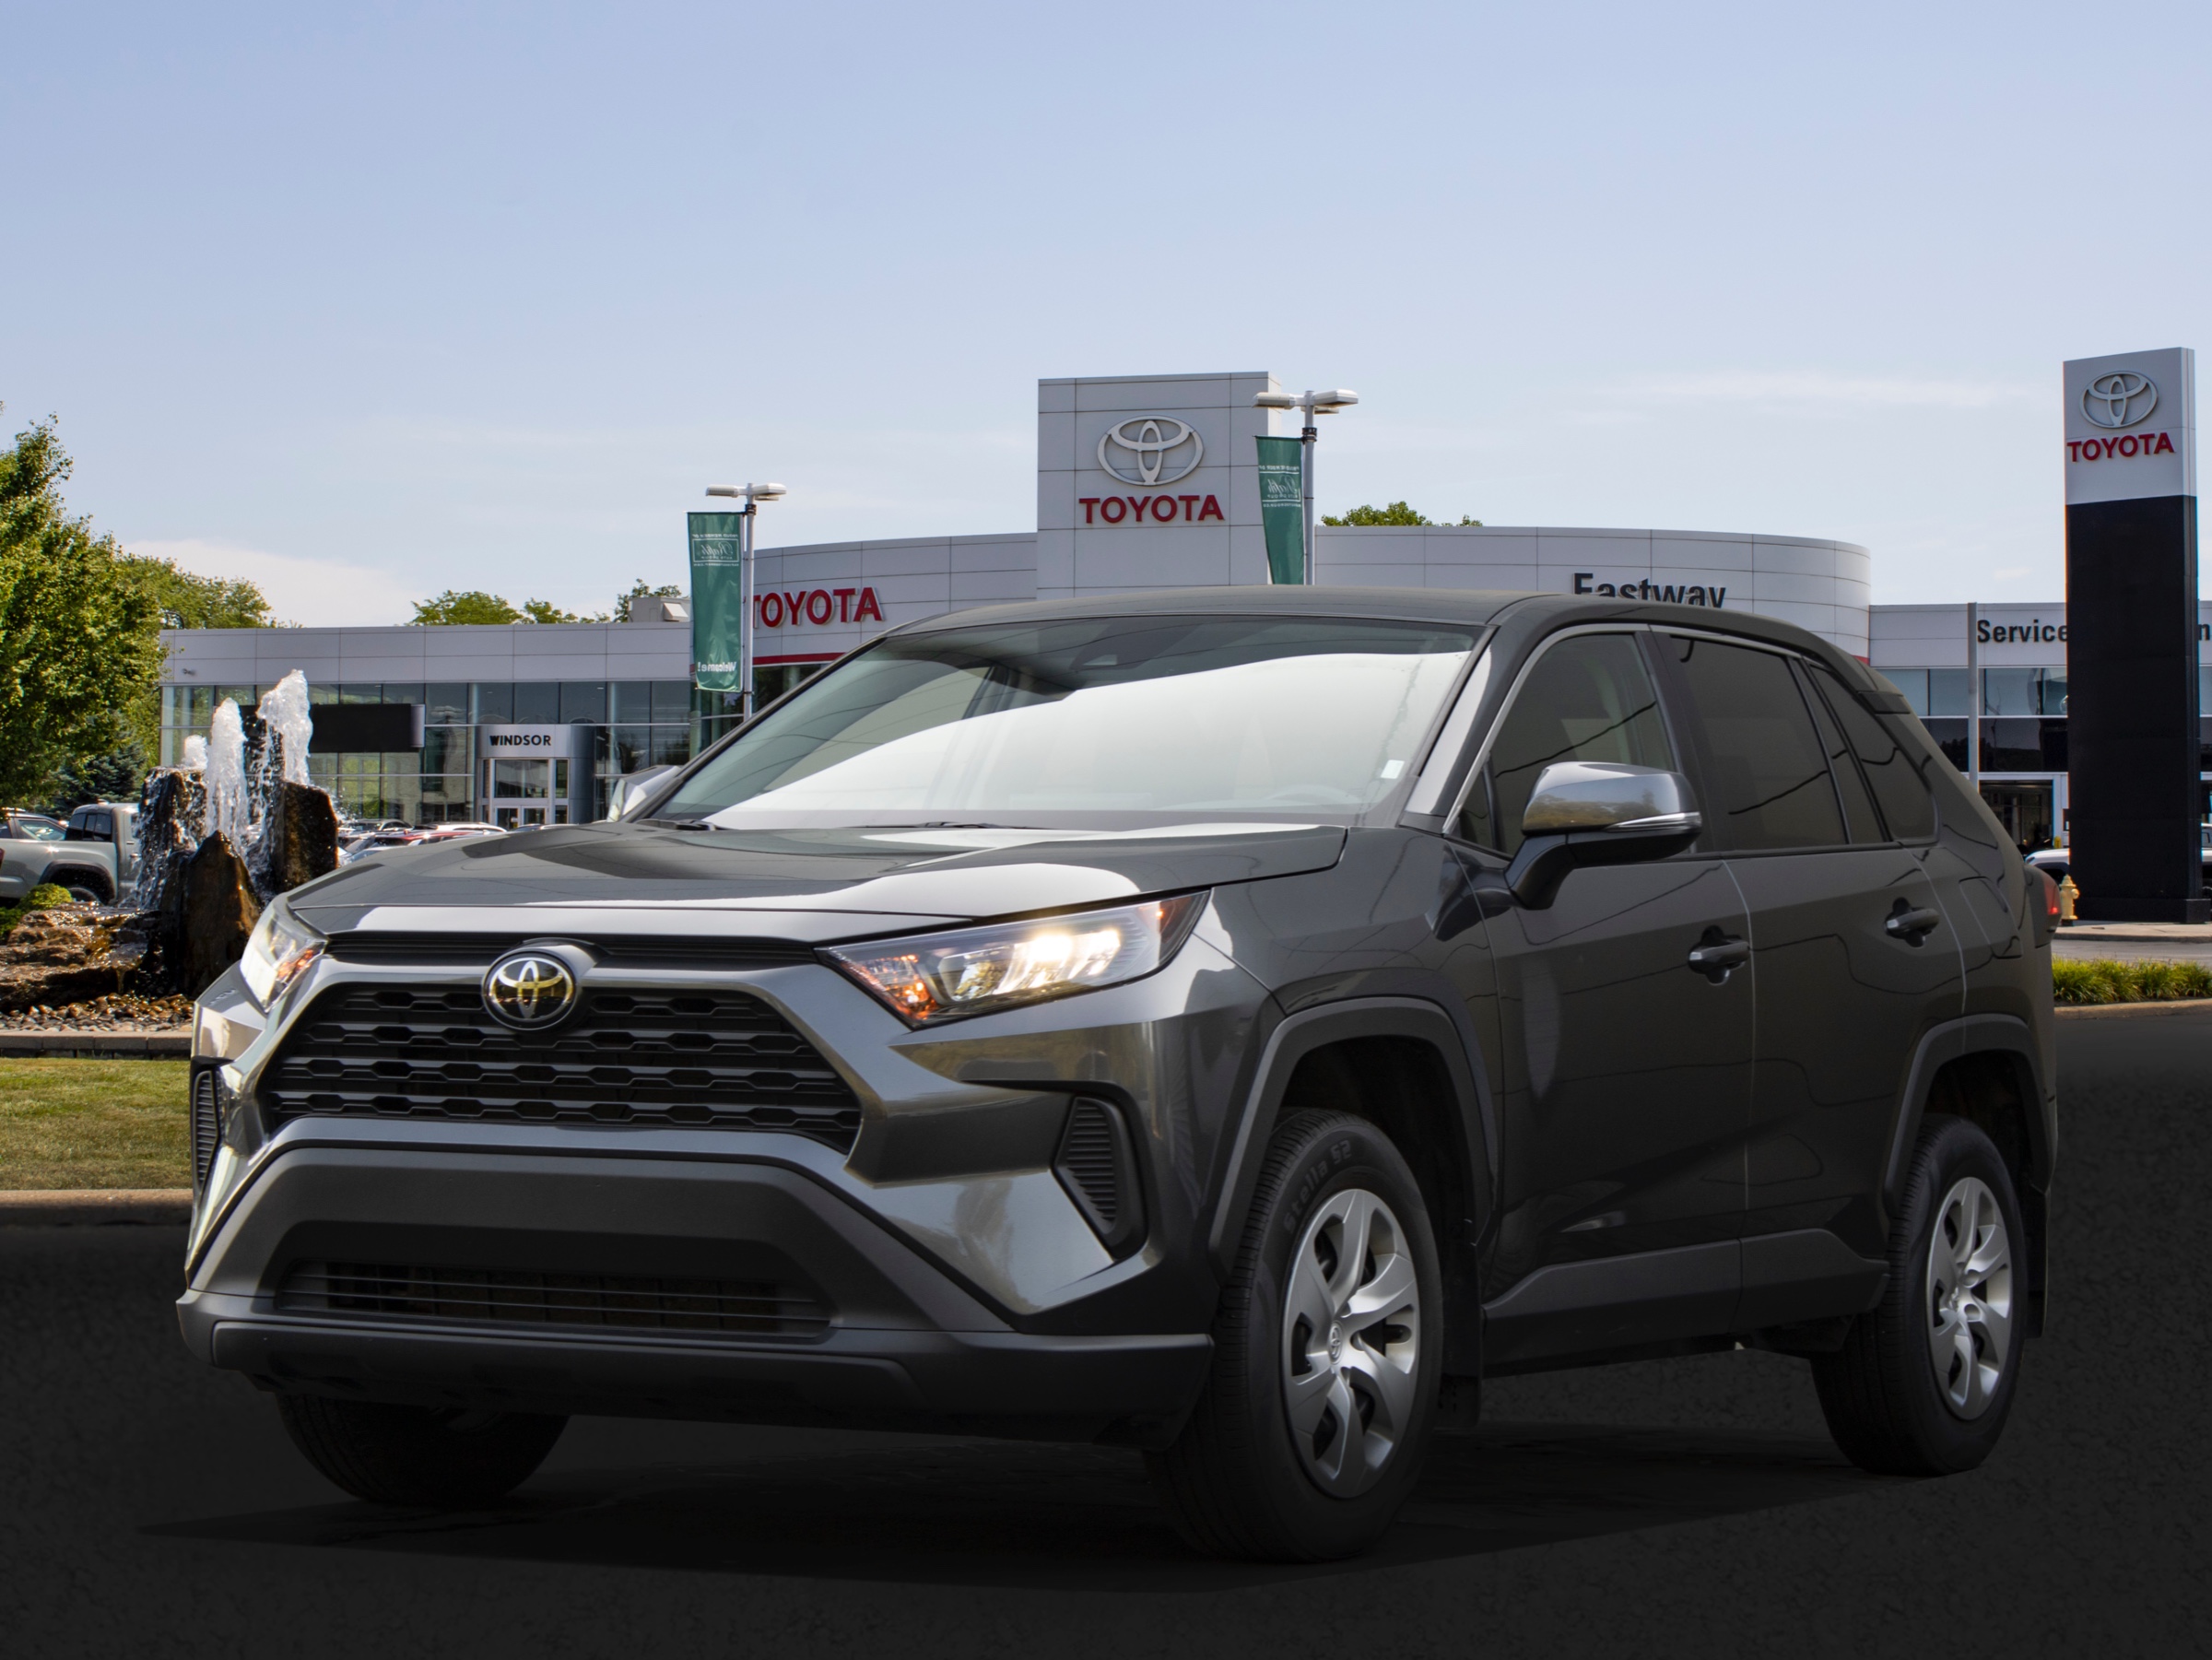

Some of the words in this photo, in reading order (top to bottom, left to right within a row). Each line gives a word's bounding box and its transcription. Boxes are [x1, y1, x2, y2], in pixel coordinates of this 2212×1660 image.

[2066, 432, 2175, 462] TOYOTA
[1078, 495, 1225, 524] TOYOTA
[1977, 619, 2068, 643] Service
[489, 735, 551, 746] WINDSOR
